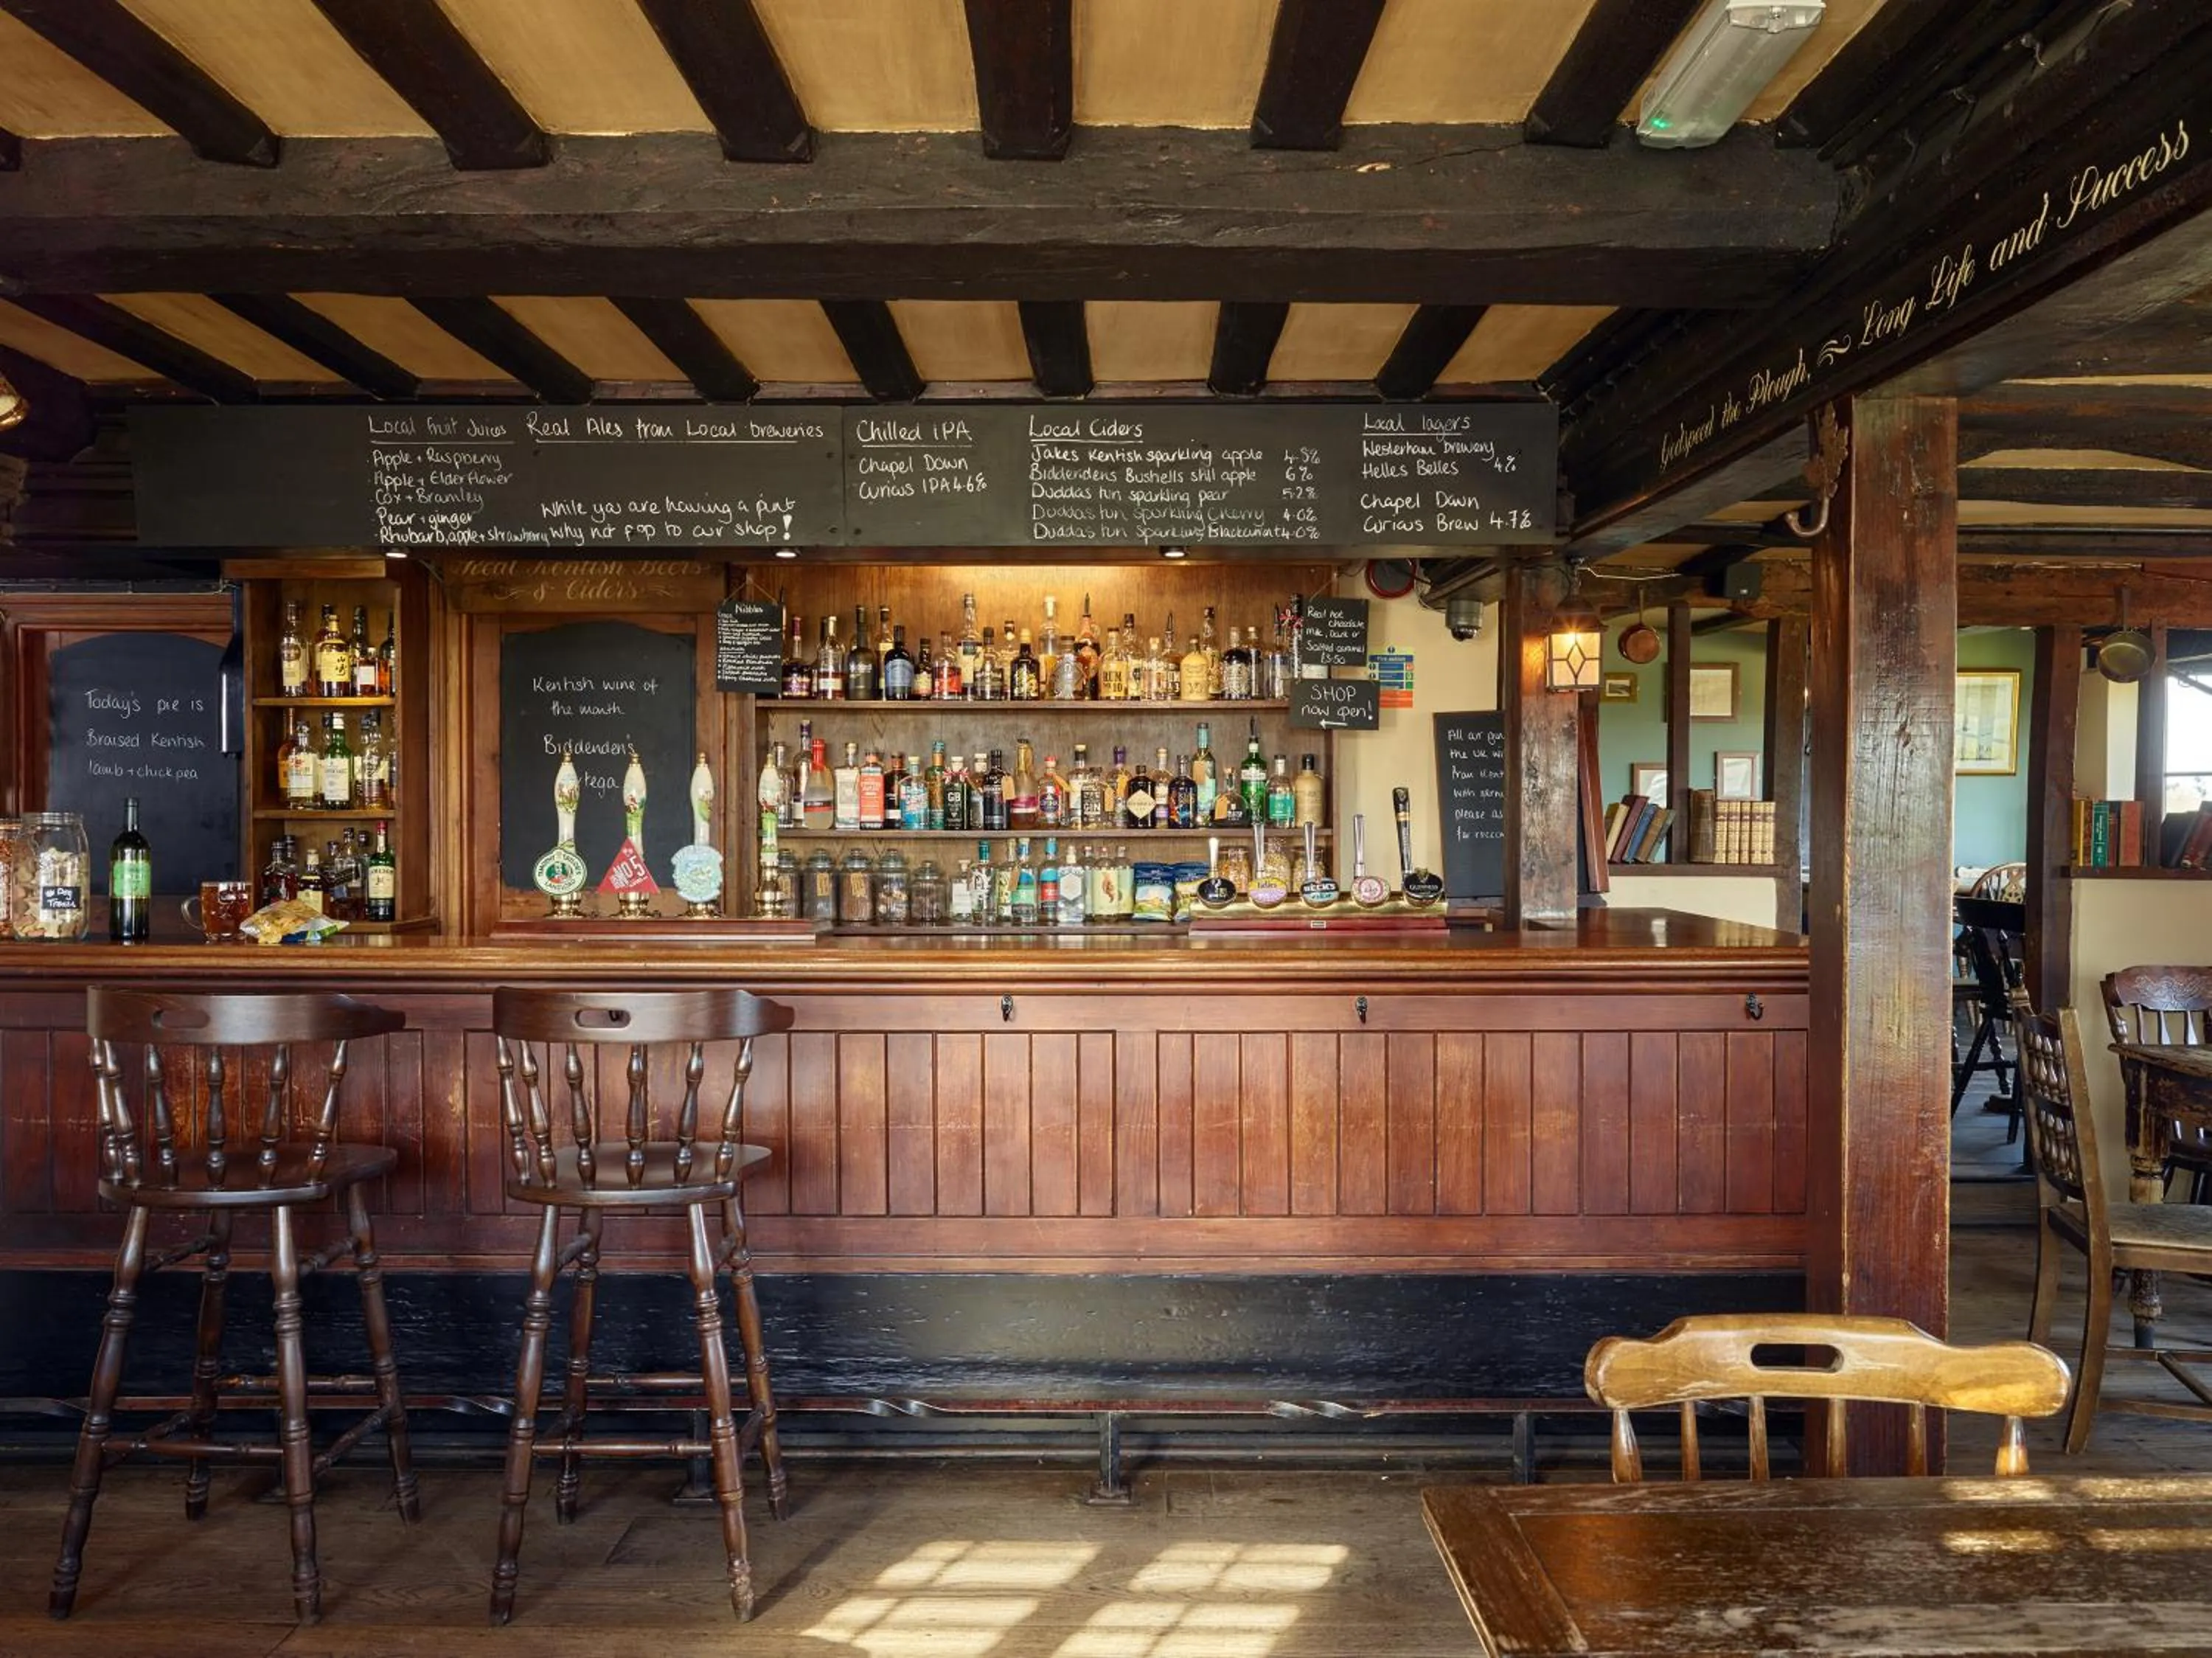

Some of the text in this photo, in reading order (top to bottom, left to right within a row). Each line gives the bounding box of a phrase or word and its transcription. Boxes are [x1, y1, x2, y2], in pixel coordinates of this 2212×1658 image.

[1722, 392, 1741, 428] the
[1859, 296, 1915, 349] Long
[1925, 244, 1976, 311] Life
[1989, 192, 2049, 271] and
[2057, 120, 2190, 229] Success
[369, 414, 416, 434] Local
[467, 417, 507, 437] Juices
[526, 411, 824, 440] Real Ales from Local breweries
[856, 420, 973, 442] Chilled IPA
[1029, 415, 1143, 439] Local Ciders
[1363, 412, 1471, 443] Local lagers
[372, 450, 414, 471] Apple
[1032, 443, 1078, 462] Jakes
[1147, 448, 1213, 467] sparkling
[1222, 448, 1263, 466] apple
[1363, 440, 1495, 462] Westerham brewery
[859, 454, 968, 480] Chapel Down
[1362, 456, 1517, 479] Helles Belles 4%
[374, 471, 419, 492] Apple
[859, 480, 915, 499] Curious
[922, 478, 951, 494] IPA
[1125, 468, 1184, 485] Bushells
[1191, 468, 1215, 481] still
[1220, 470, 1257, 488] apple
[1285, 468, 1313, 482] 6%
[375, 490, 402, 504] Cox
[416, 487, 484, 513] Bramley
[1032, 484, 1091, 499] Duddas
[1128, 487, 1191, 505] sparkling
[1198, 490, 1230, 503] pear
[1360, 490, 1480, 514] Chapel Down
[375, 507, 416, 525] Pear
[428, 510, 474, 529] ginger
[591, 503, 622, 522] you
[627, 502, 661, 514] are
[666, 493, 732, 524] having
[737, 500, 749, 512] a
[755, 493, 796, 516] pint
[1032, 504, 1096, 520] Duddas
[1034, 523, 1096, 539] Duddas
[1363, 508, 1531, 533] Curious Brew 4.7%
[591, 524, 613, 539] not
[665, 524, 682, 537] to
[692, 525, 723, 538] our
[1307, 606, 1344, 618] Real hot
[533, 677, 658, 694] Kentish wine of
[1310, 684, 1356, 701] SHOP
[84, 689, 204, 719] Today's pie is
[550, 700, 625, 715] the month
[1301, 704, 1330, 716] now
[1450, 749, 1468, 759] the
[88, 760, 124, 775] lamb
[1452, 766, 1473, 780] from
[947, 792, 960, 802] GB
[1455, 808, 1485, 820] please
